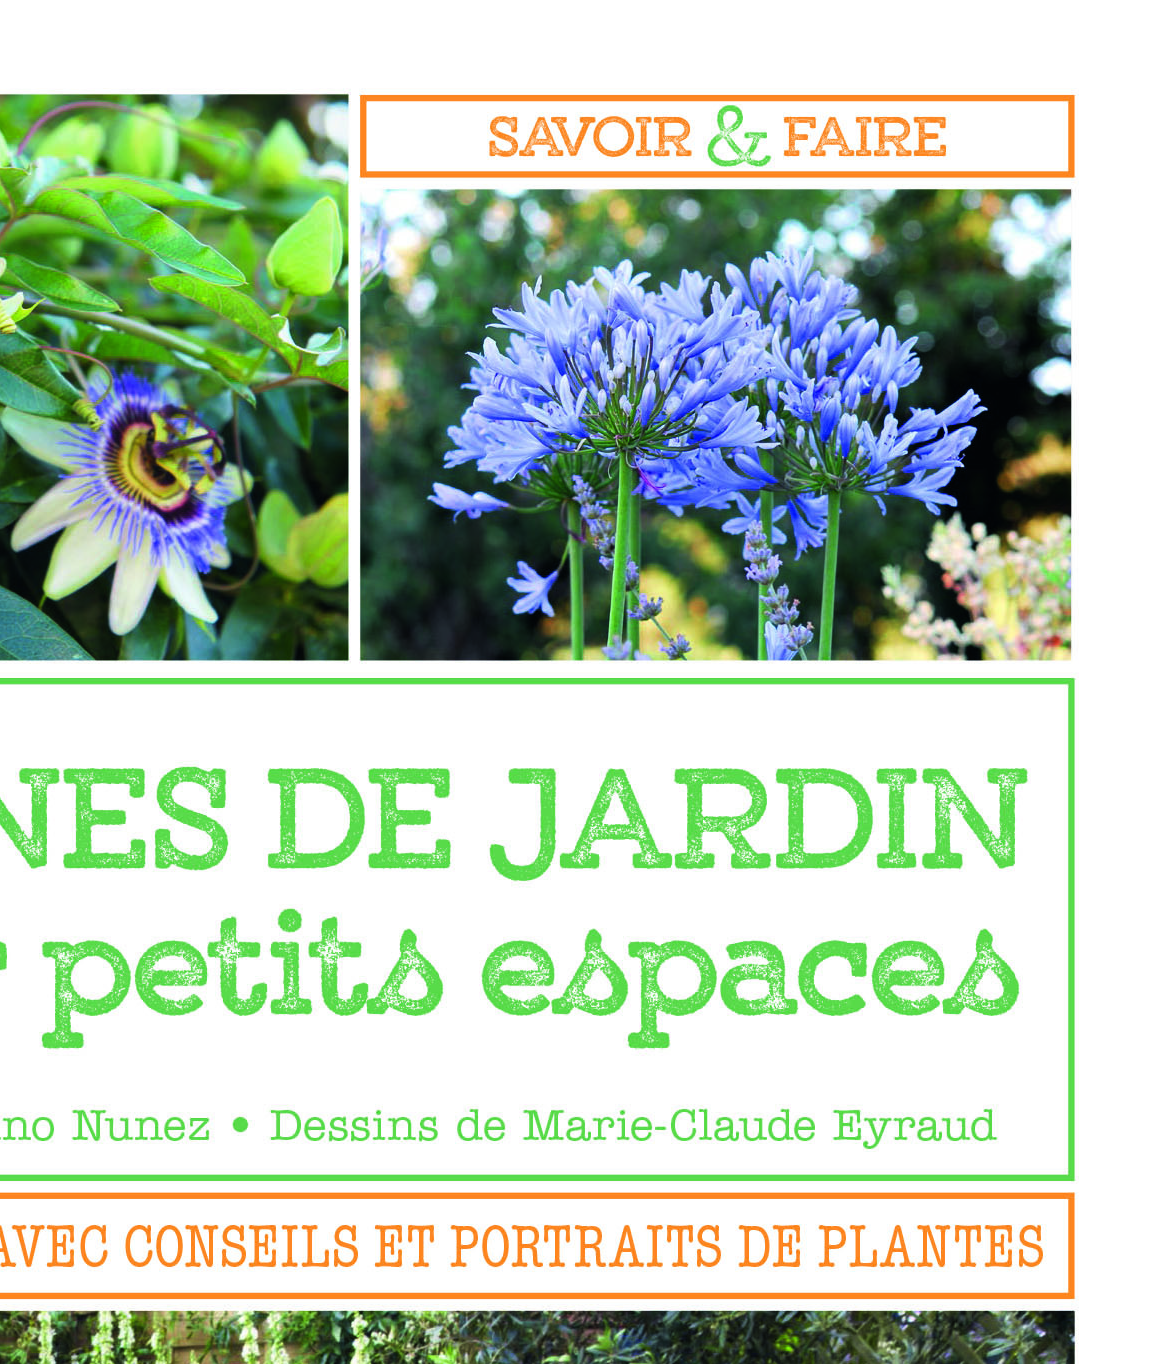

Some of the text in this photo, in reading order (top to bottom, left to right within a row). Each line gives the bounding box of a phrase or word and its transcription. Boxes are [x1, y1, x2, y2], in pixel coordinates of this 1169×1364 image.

[488, 104, 947, 168] SAVOIR & FAIRE
[267, 767, 451, 870] DE
[489, 767, 1028, 882] JARDIN
[42, 908, 444, 1050] petits
[481, 928, 1020, 1050] espaces
[72, 1109, 211, 1142] Nunez
[271, 1109, 439, 1143] Dessins
[457, 1108, 506, 1142] de
[523, 1107, 816, 1143] Marie-Claude
[833, 1107, 998, 1150] Eyraud
[125, 1224, 359, 1269] CONSEILS
[375, 1223, 435, 1269] ET
[450, 1224, 722, 1269] PORTRAITS
[738, 1224, 802, 1269] DE
[818, 1223, 1044, 1269] PLANTES
